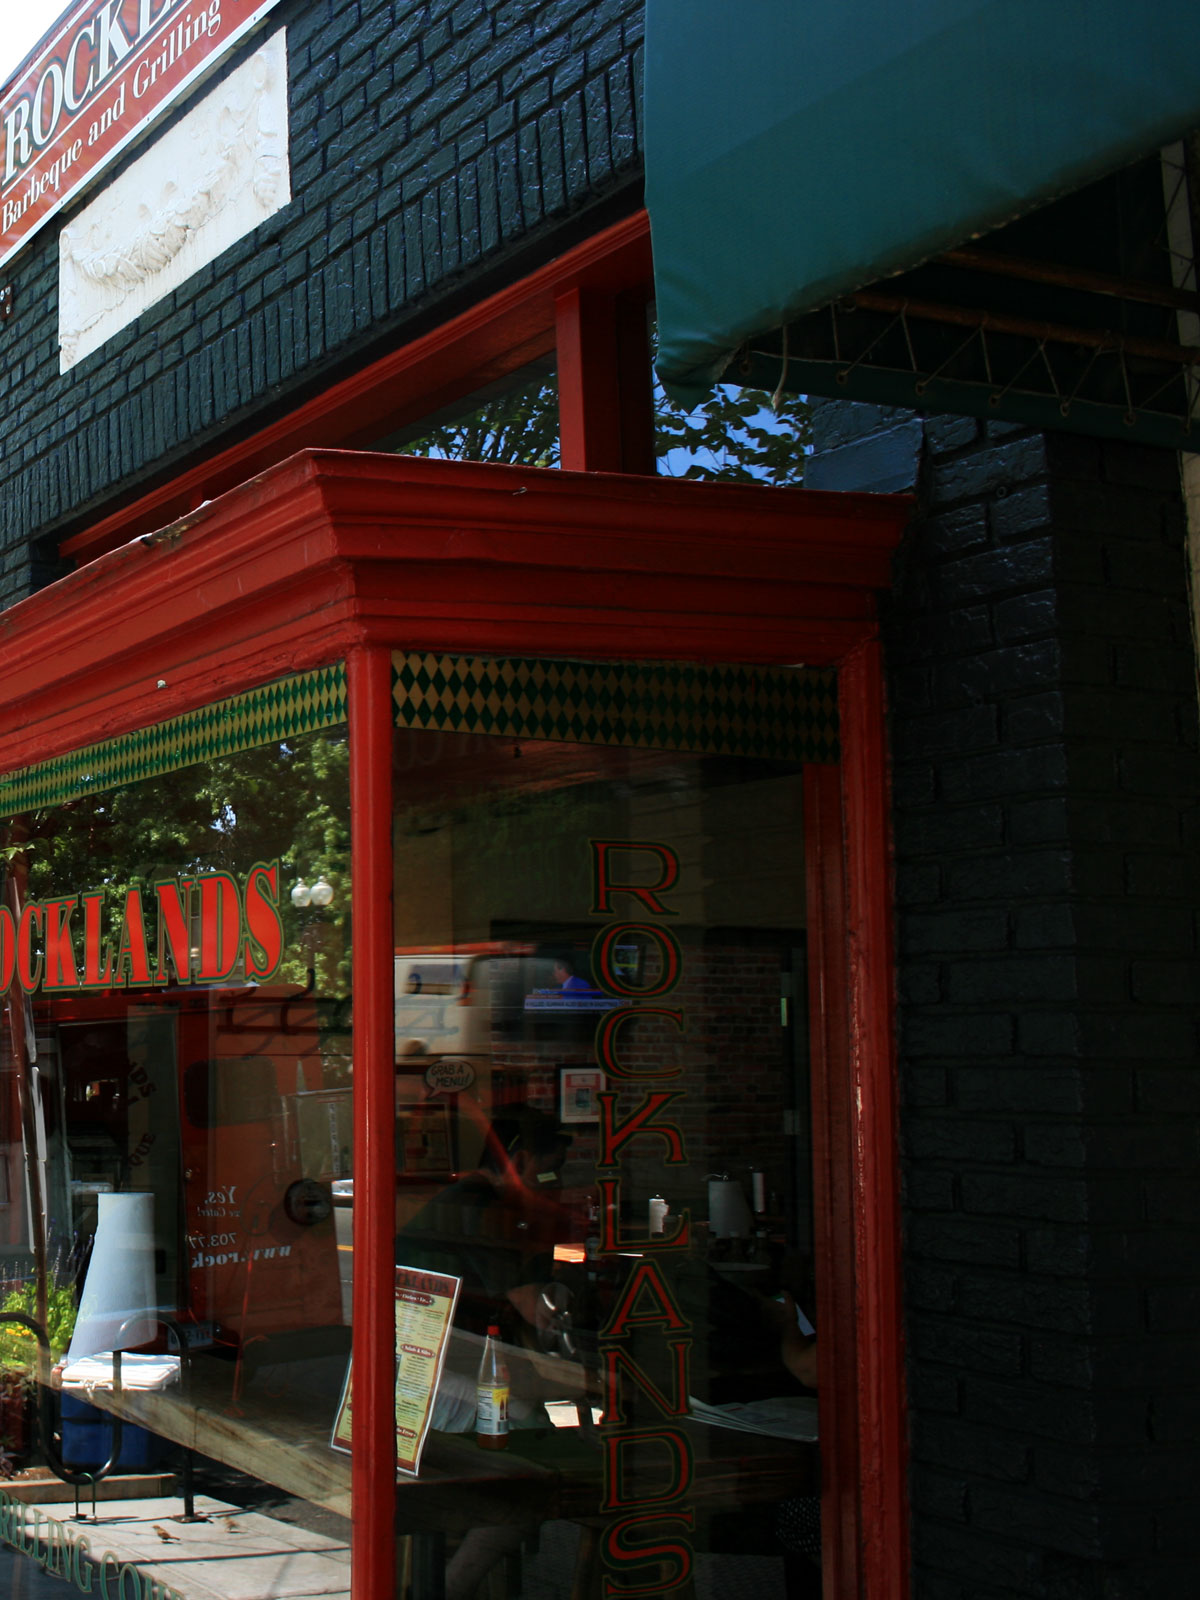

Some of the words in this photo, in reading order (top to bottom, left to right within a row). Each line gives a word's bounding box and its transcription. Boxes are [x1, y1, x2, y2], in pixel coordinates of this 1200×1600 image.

[0, 138, 84, 236] Barbeque
[88, 81, 126, 146] and
[133, 0, 221, 99] Grilling
[1, 0, 178, 187] ROCKL
[431, 1063, 456, 1076] GRAB
[457, 1064, 465, 1074] A
[435, 1072, 471, 1088] MENU!
[587, 838, 698, 1600] ROCKLANDS
